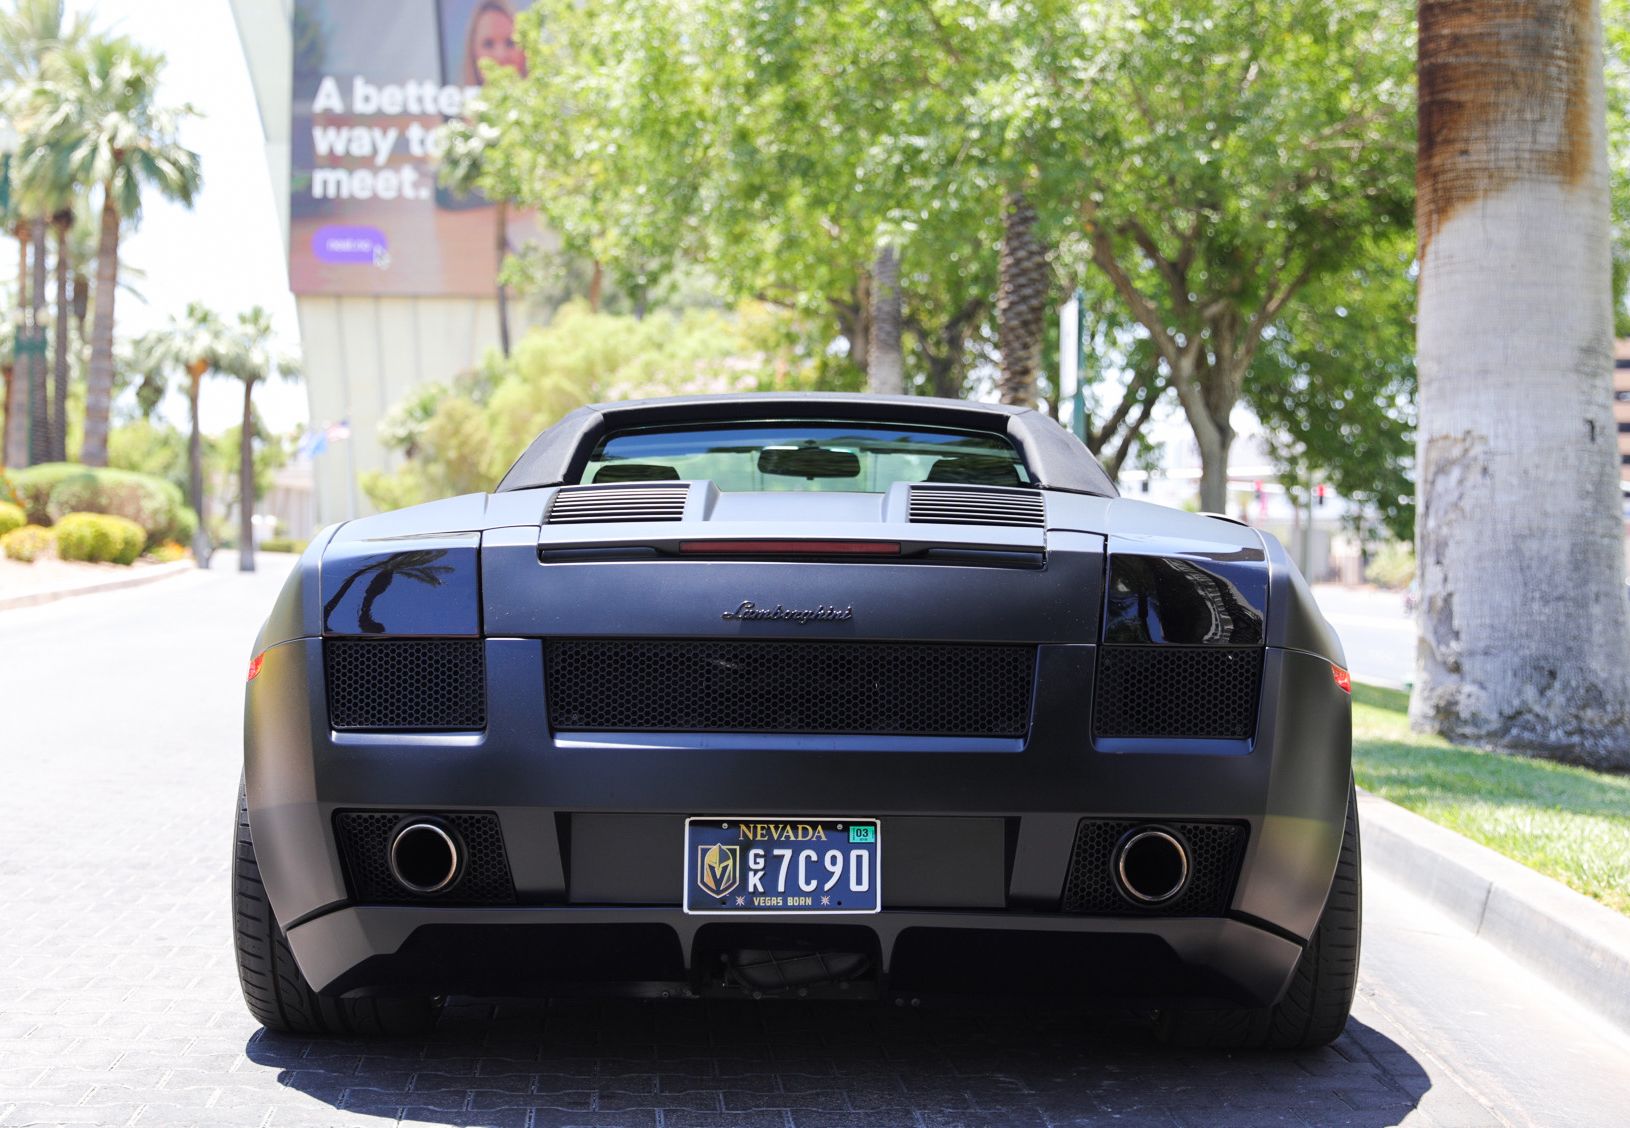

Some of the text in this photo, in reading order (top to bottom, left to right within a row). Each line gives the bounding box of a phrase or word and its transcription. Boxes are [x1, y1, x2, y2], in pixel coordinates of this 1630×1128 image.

[312, 76, 345, 114] A
[312, 125, 399, 166] way
[311, 164, 431, 199] meet.
[720, 600, 853, 624] Lamborghini
[738, 823, 827, 841] NEVADA
[855, 828, 869, 838] 03
[773, 849, 870, 892] 7C90
[753, 897, 812, 906] VEGAS BORN
